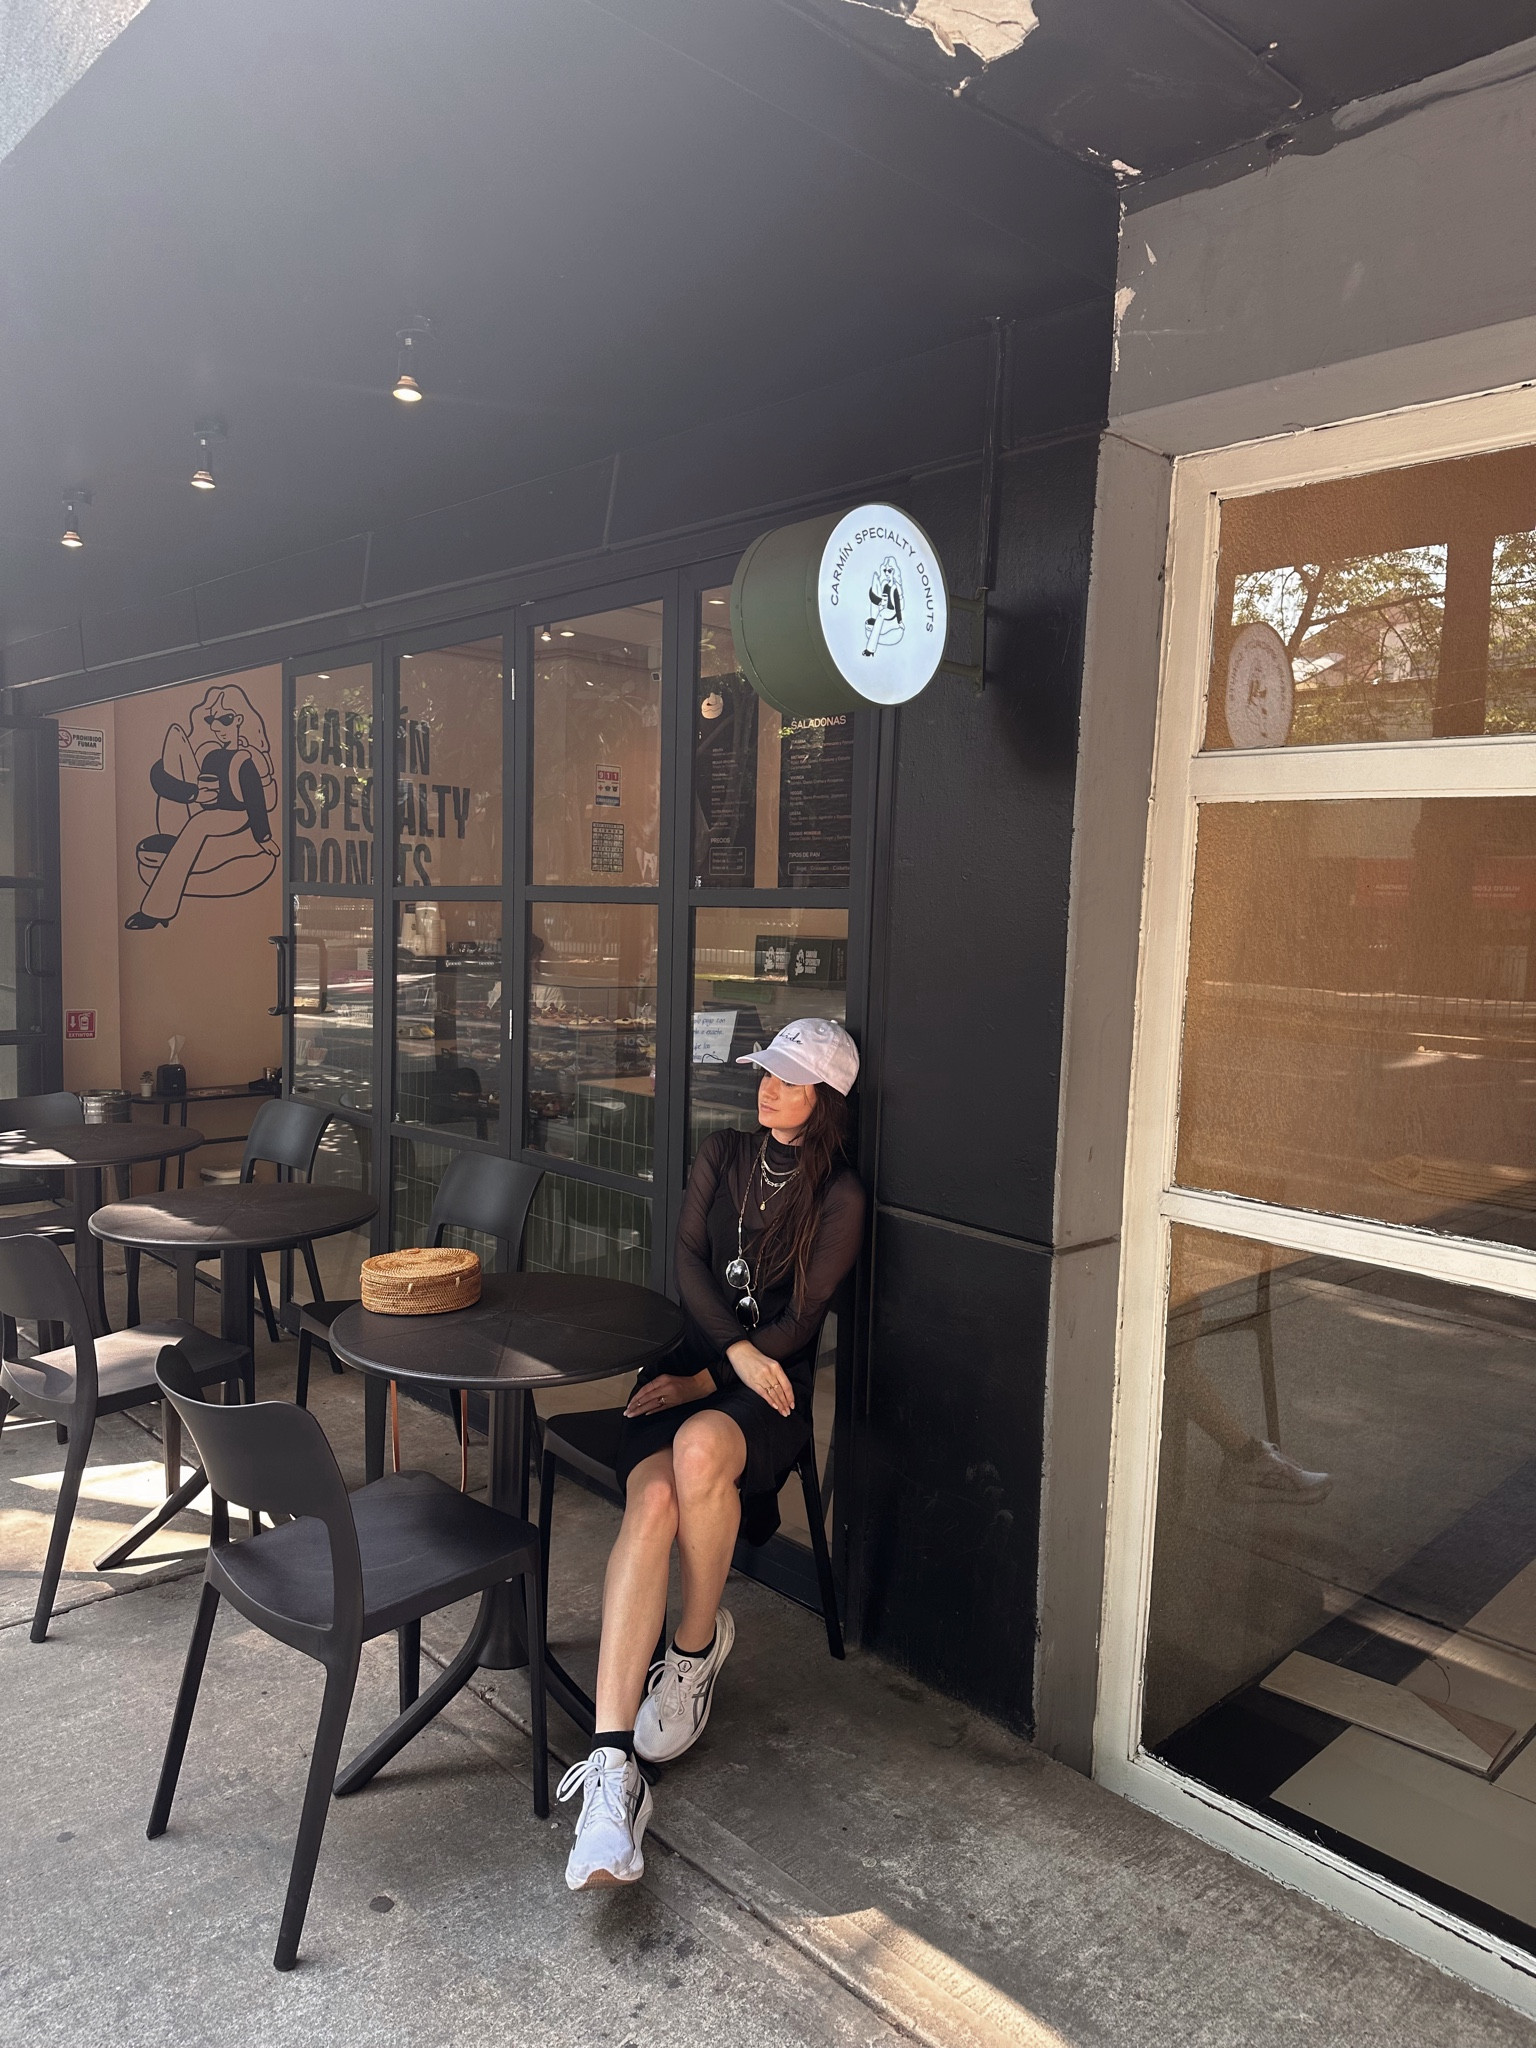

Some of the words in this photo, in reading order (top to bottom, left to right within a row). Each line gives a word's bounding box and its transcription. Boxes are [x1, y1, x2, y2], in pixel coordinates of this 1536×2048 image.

[830, 542, 854, 607] CARMÍN
[855, 527, 916, 558] SPECIALTY
[916, 562, 934, 633] DONUTS
[72, 734, 102, 743] PROHIBIDO
[297, 705, 430, 776] CARÍN
[791, 715, 847, 730] SALADONAS
[598, 771, 619, 781] 911
[296, 770, 471, 840] SPECALTY
[296, 836, 432, 887] DONTS
